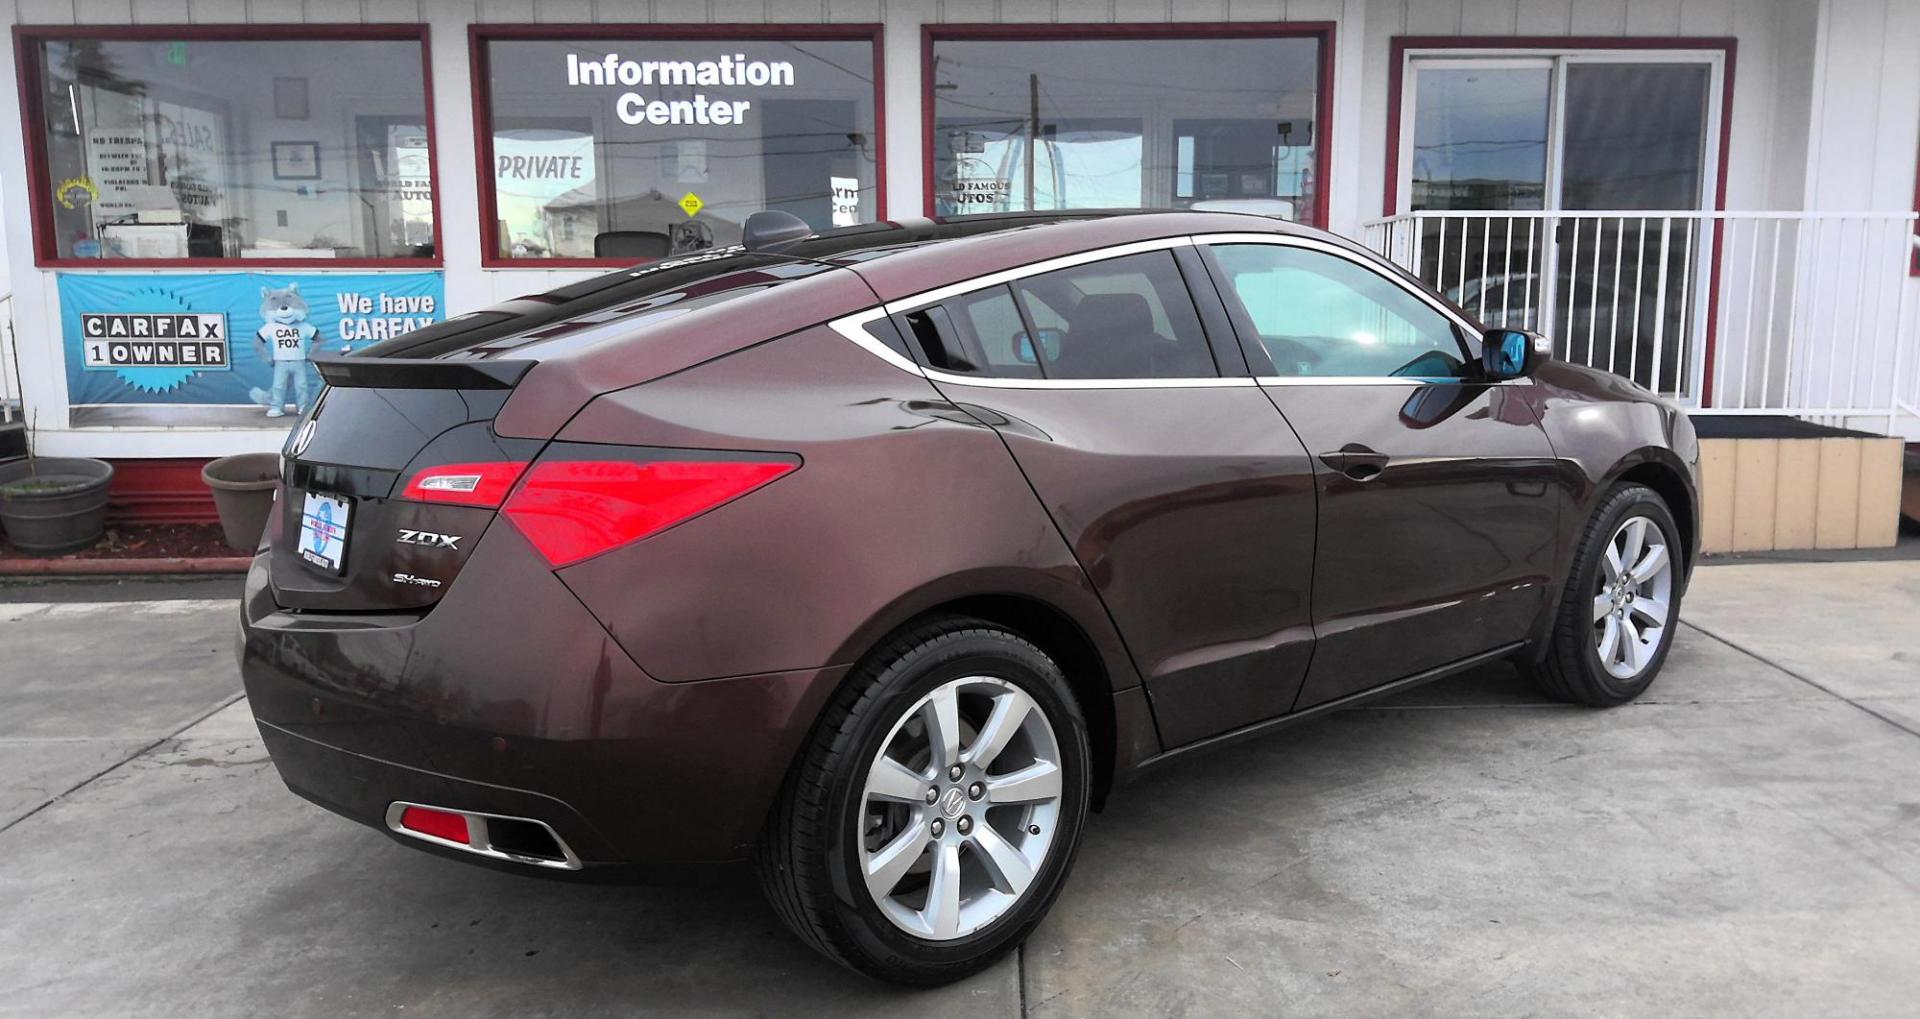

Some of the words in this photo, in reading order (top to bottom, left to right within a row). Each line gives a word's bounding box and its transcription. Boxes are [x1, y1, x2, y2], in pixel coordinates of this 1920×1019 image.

[567, 53, 795, 86] Information
[616, 92, 751, 125] Center
[498, 155, 583, 180] PRIVATE
[957, 193, 994, 204] UTOS
[337, 293, 373, 314] We
[380, 293, 435, 314] have
[86, 317, 219, 339] CARFAX
[276, 329, 300, 339] CAR
[92, 345, 105, 362] 1
[112, 346, 222, 362] OWNER
[278, 339, 300, 349] FOX
[396, 529, 463, 550] ZDX
